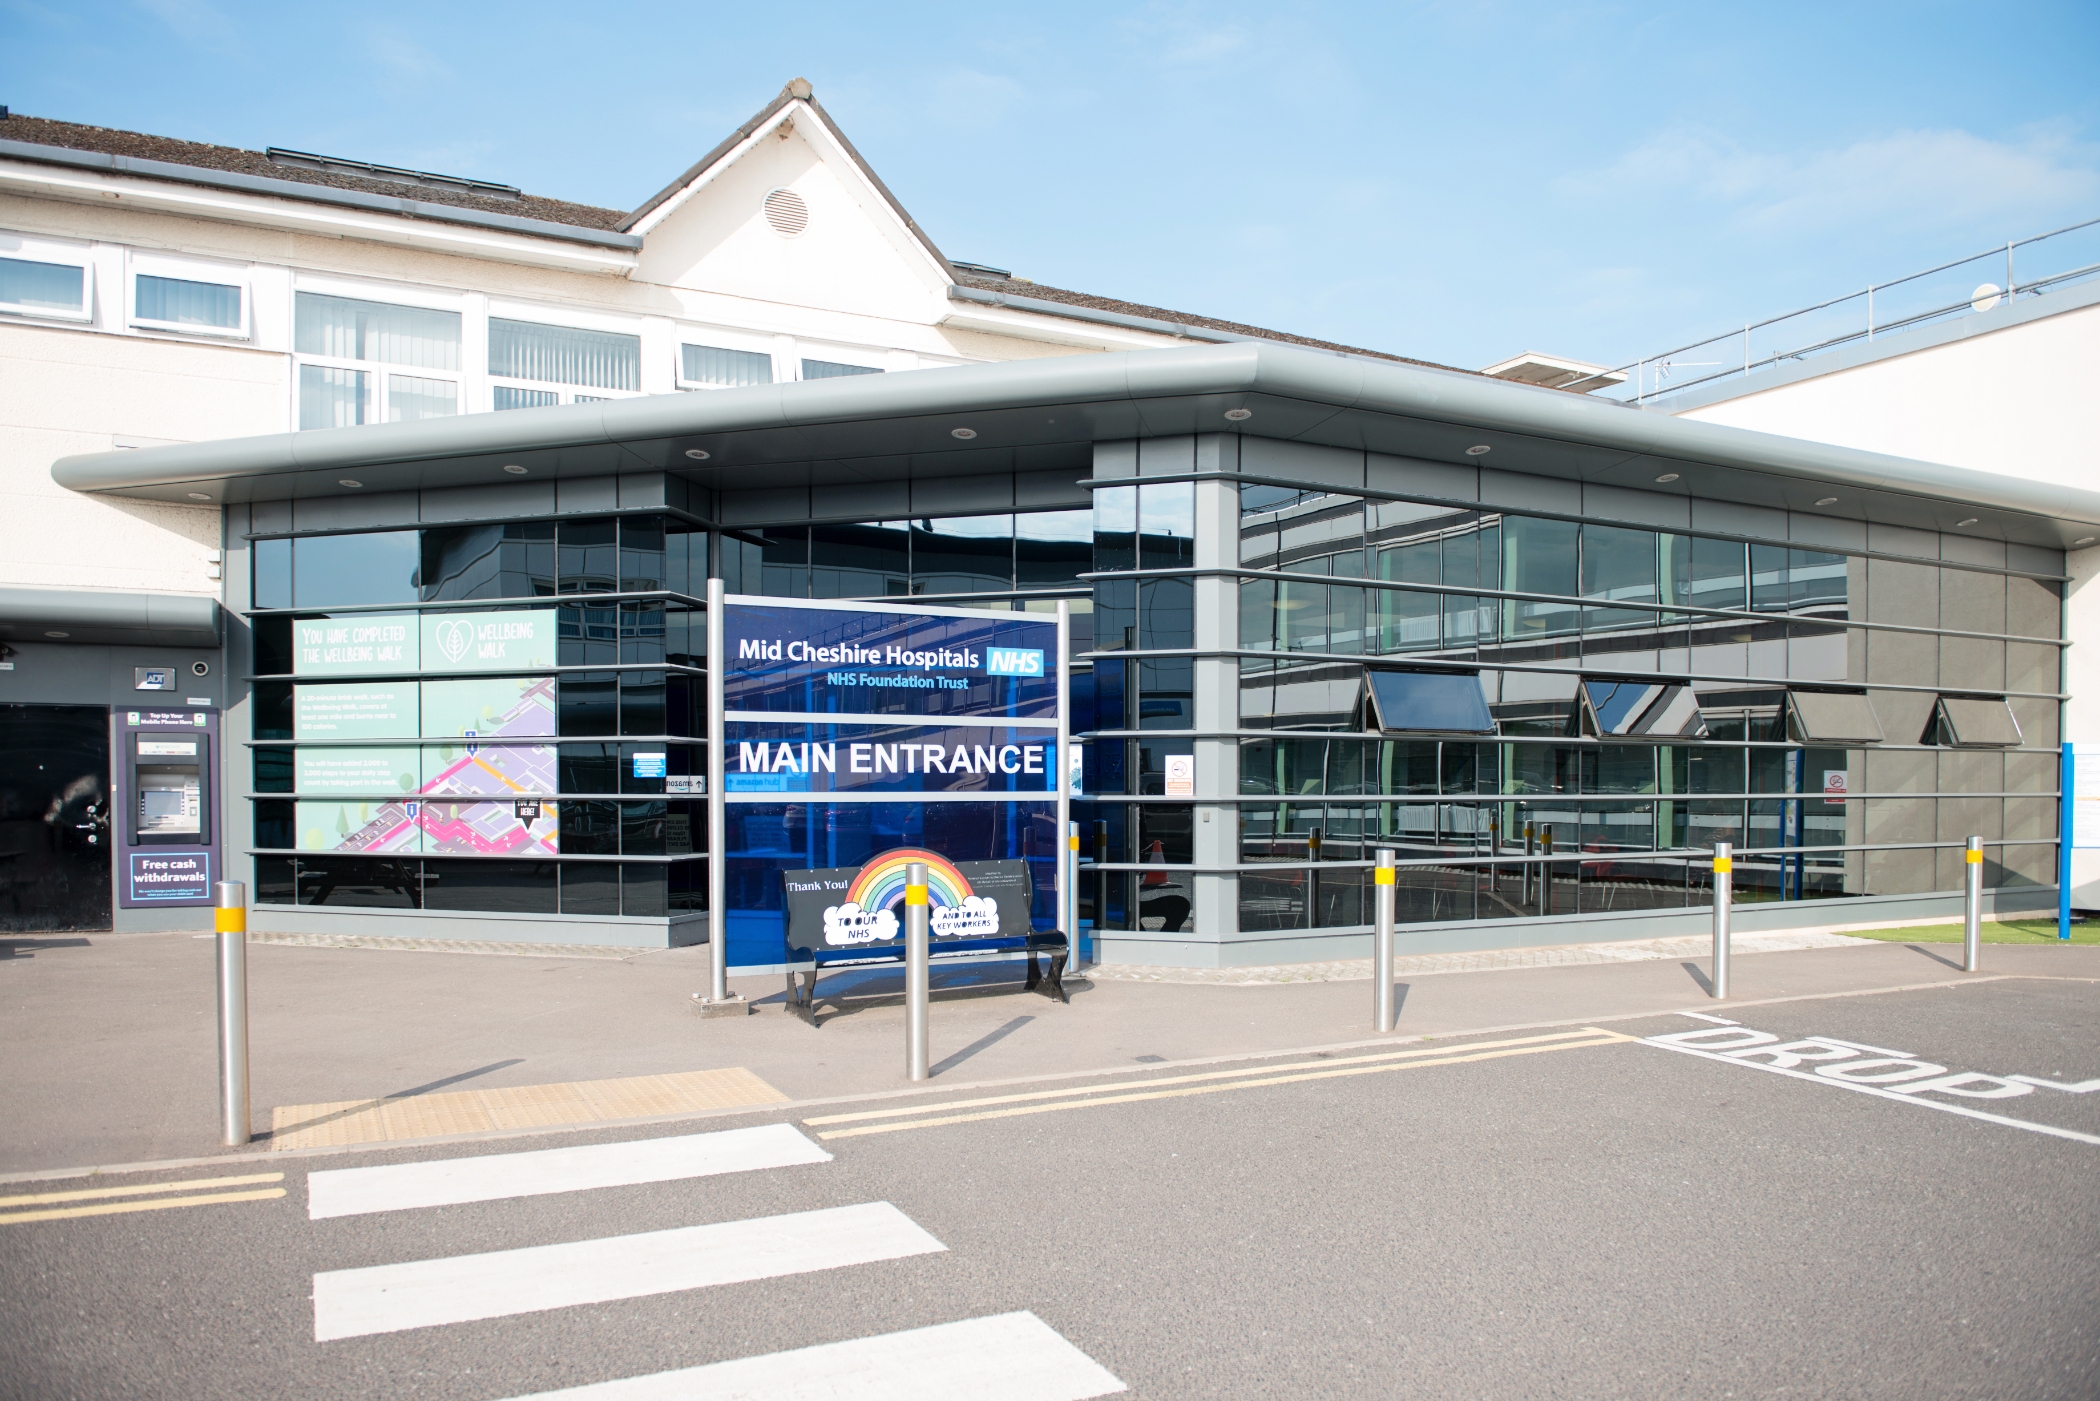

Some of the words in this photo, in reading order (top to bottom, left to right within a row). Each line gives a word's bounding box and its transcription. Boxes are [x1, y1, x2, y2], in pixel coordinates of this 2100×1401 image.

[302, 628, 322, 645] YOU
[327, 628, 348, 644] HAVE
[353, 626, 406, 643] COMPLETED
[478, 622, 533, 640] WELLBEING
[303, 648, 320, 663] THE
[324, 646, 373, 663] WELLBEING
[377, 645, 402, 661] WALK
[478, 642, 505, 658] WALK
[739, 639, 782, 660] Mid
[788, 640, 881, 664] Cheshire
[886, 646, 979, 671] Hospitals
[990, 651, 1040, 673] NHS
[828, 672, 856, 686] NHS
[860, 673, 934, 689] Foundation
[937, 676, 968, 689] Trust
[740, 742, 835, 772] MAIN
[850, 743, 1044, 773] ENTRANCE
[330, 779, 349, 787] taking
[142, 860, 168, 869] Free
[170, 859, 196, 869] cash
[134, 872, 205, 882] withdrawals
[788, 881, 821, 892] Thank
[824, 879, 848, 890] You!
[838, 917, 852, 927] TO
[855, 916, 878, 926] OUR
[942, 912, 959, 920] AND
[848, 929, 869, 939] NHS
[1645, 1026, 2035, 1099] DROP
